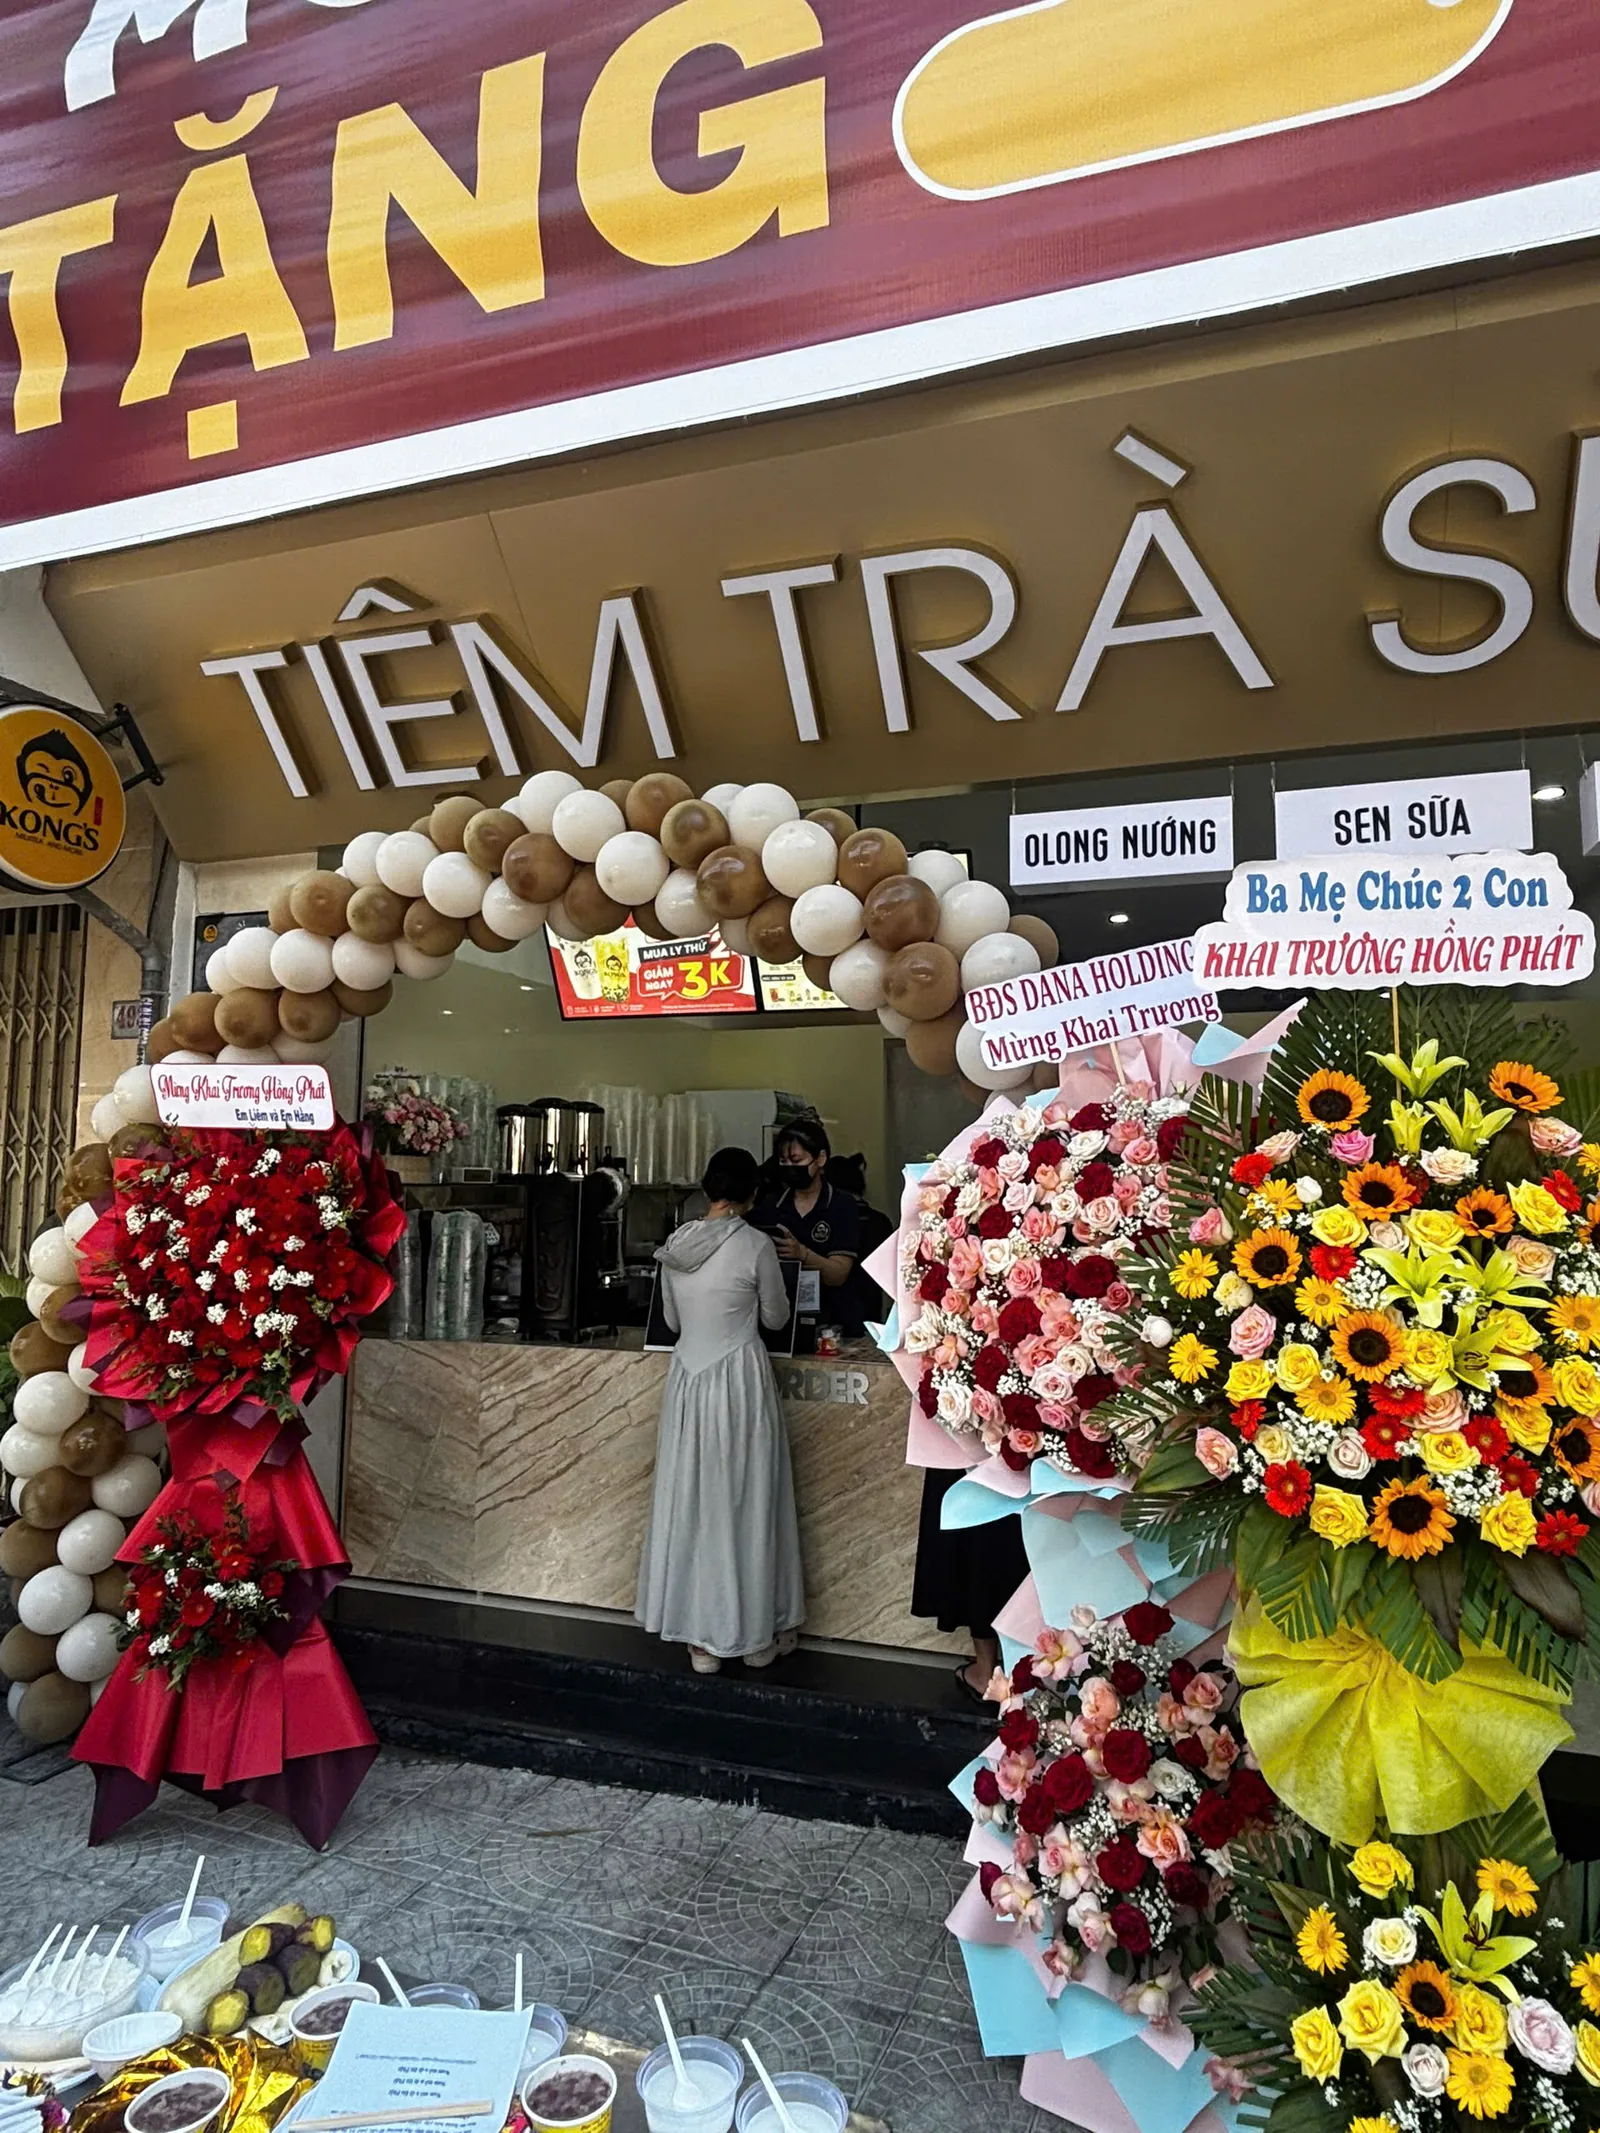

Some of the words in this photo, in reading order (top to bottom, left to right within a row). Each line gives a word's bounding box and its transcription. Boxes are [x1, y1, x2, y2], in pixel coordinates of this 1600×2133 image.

[0, 0, 831, 461] TẶNG
[721, 434, 1276, 742] TRÀ
[1371, 436, 1600, 674] S
[1024, 827, 1109, 867] OLONG
[1122, 816, 1217, 859] NƯỚNG
[1334, 806, 1391, 846] SEN
[1409, 795, 1471, 838] SỮA
[1246, 873, 1287, 914] Ba
[1299, 871, 1347, 923] Mẹ
[1356, 867, 1442, 912] Chúc
[1453, 874, 1473, 911] 2
[1483, 867, 1549, 908] Con
[643, 947, 666, 960] MUA
[669, 945, 682, 956] LY
[684, 940, 707, 954] THỨ
[643, 964, 674, 980] GIẢM
[1203, 939, 1280, 979] KHAI
[1287, 931, 1405, 977] TRƯƠNG
[1410, 918, 1495, 974] HỒNG
[1500, 924, 1584, 972] PHÁT
[645, 979, 674, 991] NGAY
[968, 982, 1019, 1024] BĐS
[1019, 966, 1090, 1012] DANA
[1088, 939, 1195, 994] HOLDING
[985, 1030, 1063, 1068] Mừng
[1060, 1009, 1121, 1049] Khai
[1120, 992, 1221, 1033] Trương
[191, 1075, 220, 1103] Khai
[261, 1075, 294, 1105] Hồng
[295, 1076, 326, 1104] Phát
[235, 1108, 249, 1121] Em
[270, 1109, 280, 1122] và
[280, 1109, 294, 1122] Em
[775, 1368, 870, 1405] RDER
